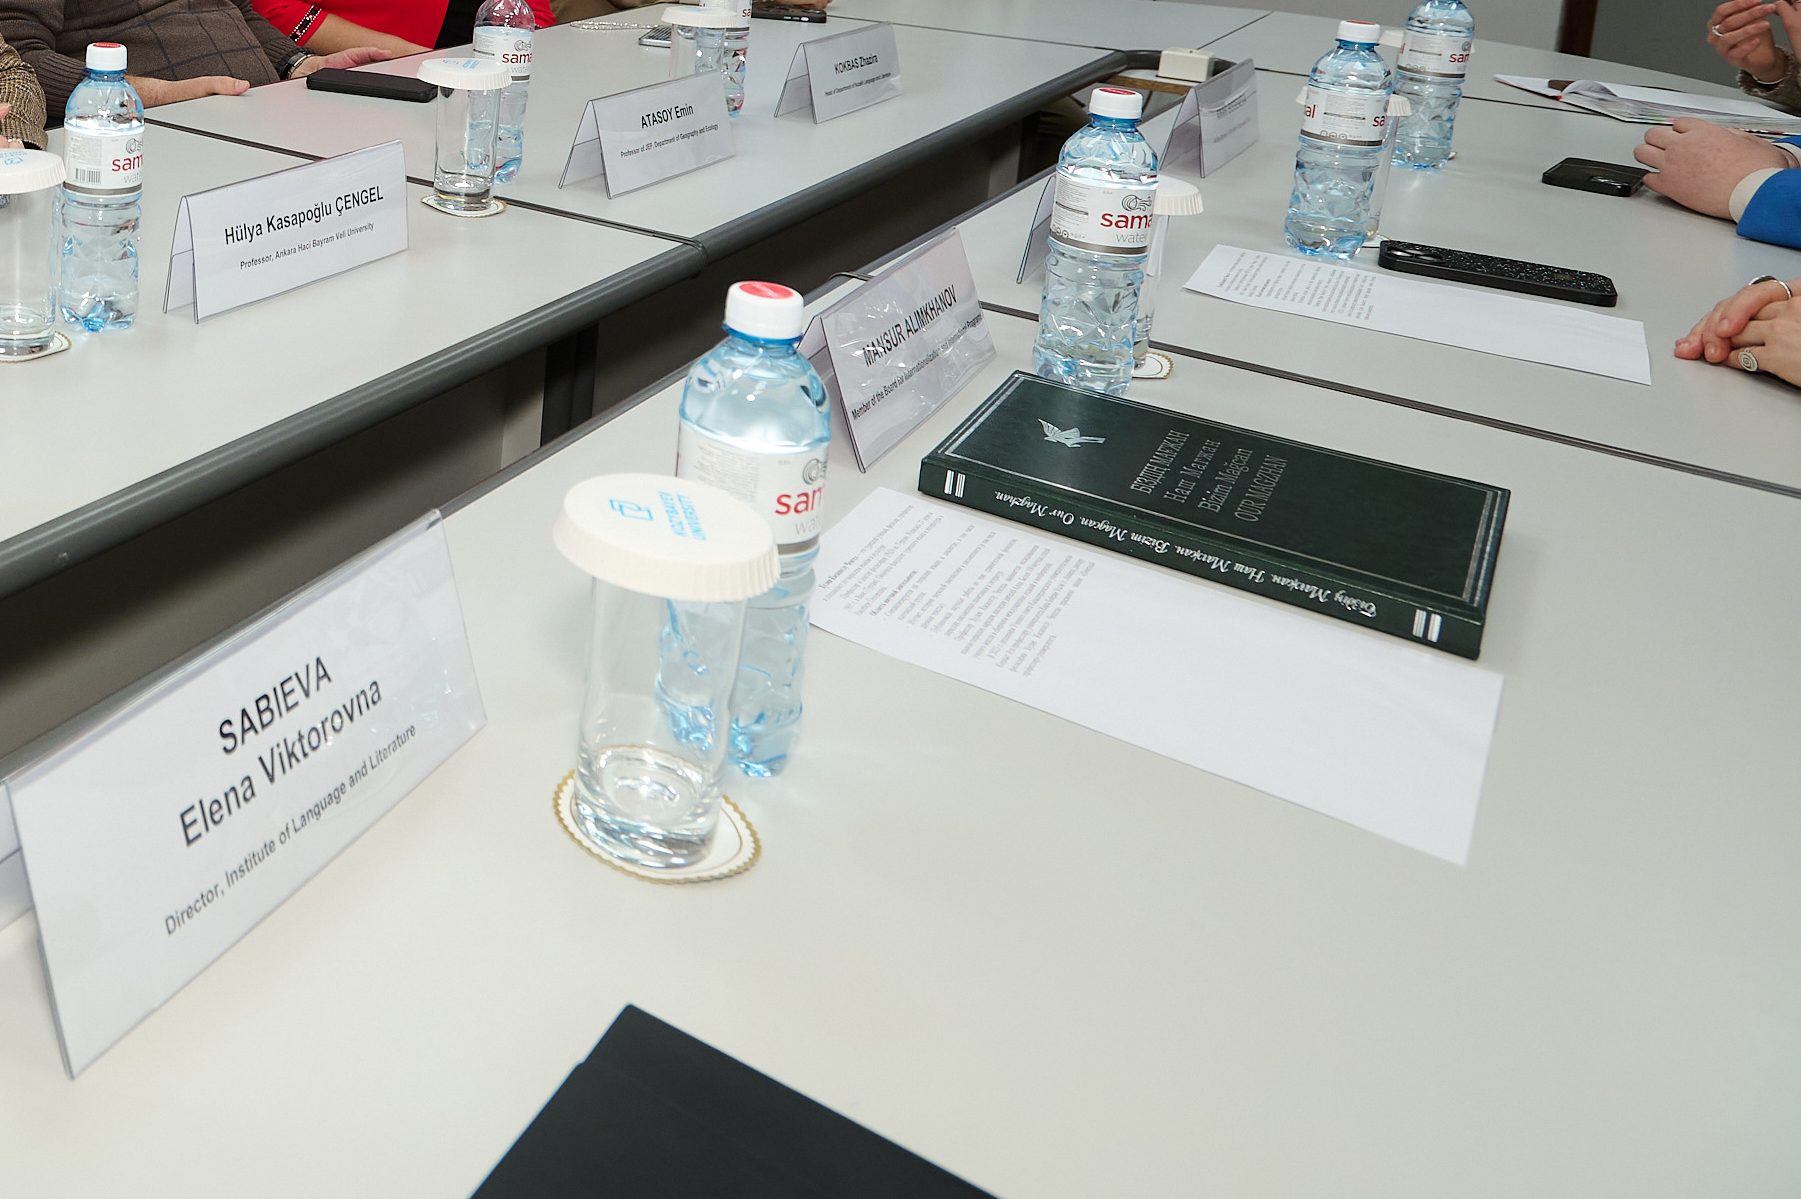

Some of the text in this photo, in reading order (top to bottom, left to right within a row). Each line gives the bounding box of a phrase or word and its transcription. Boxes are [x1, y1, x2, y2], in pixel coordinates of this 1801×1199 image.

[834, 58, 859, 74] KOKBAS
[641, 104, 694, 128] ATASOY Emin
[224, 186, 384, 245] Hülya Kasapoğlu ÇENGEL
[240, 254, 274, 270] Professor,
[275, 246, 297, 260] Ankara
[312, 235, 334, 249] Bayram
[335, 230, 346, 241] Veli
[347, 222, 374, 237] University
[862, 284, 957, 367] MANSUR ALIMKHANOV
[851, 400, 871, 420] Member
[876, 390, 884, 402] the
[883, 380, 898, 399] Board
[1130, 463, 1170, 495] БІЗДІҢ
[1163, 439, 1221, 503] Наш Магжан
[1234, 454, 1288, 522] OUR MAGZHAN
[994, 490, 1048, 517] Magzhan.
[1049, 510, 1075, 525] Our
[1198, 486, 1233, 513] Bizim
[1130, 531, 1171, 554] Bizim
[1233, 562, 1266, 583] Наш
[218, 655, 333, 756] SABIEVA
[179, 678, 383, 848] Elena Viktorovna
[165, 724, 417, 936] Director, Institute of Language and Literature
